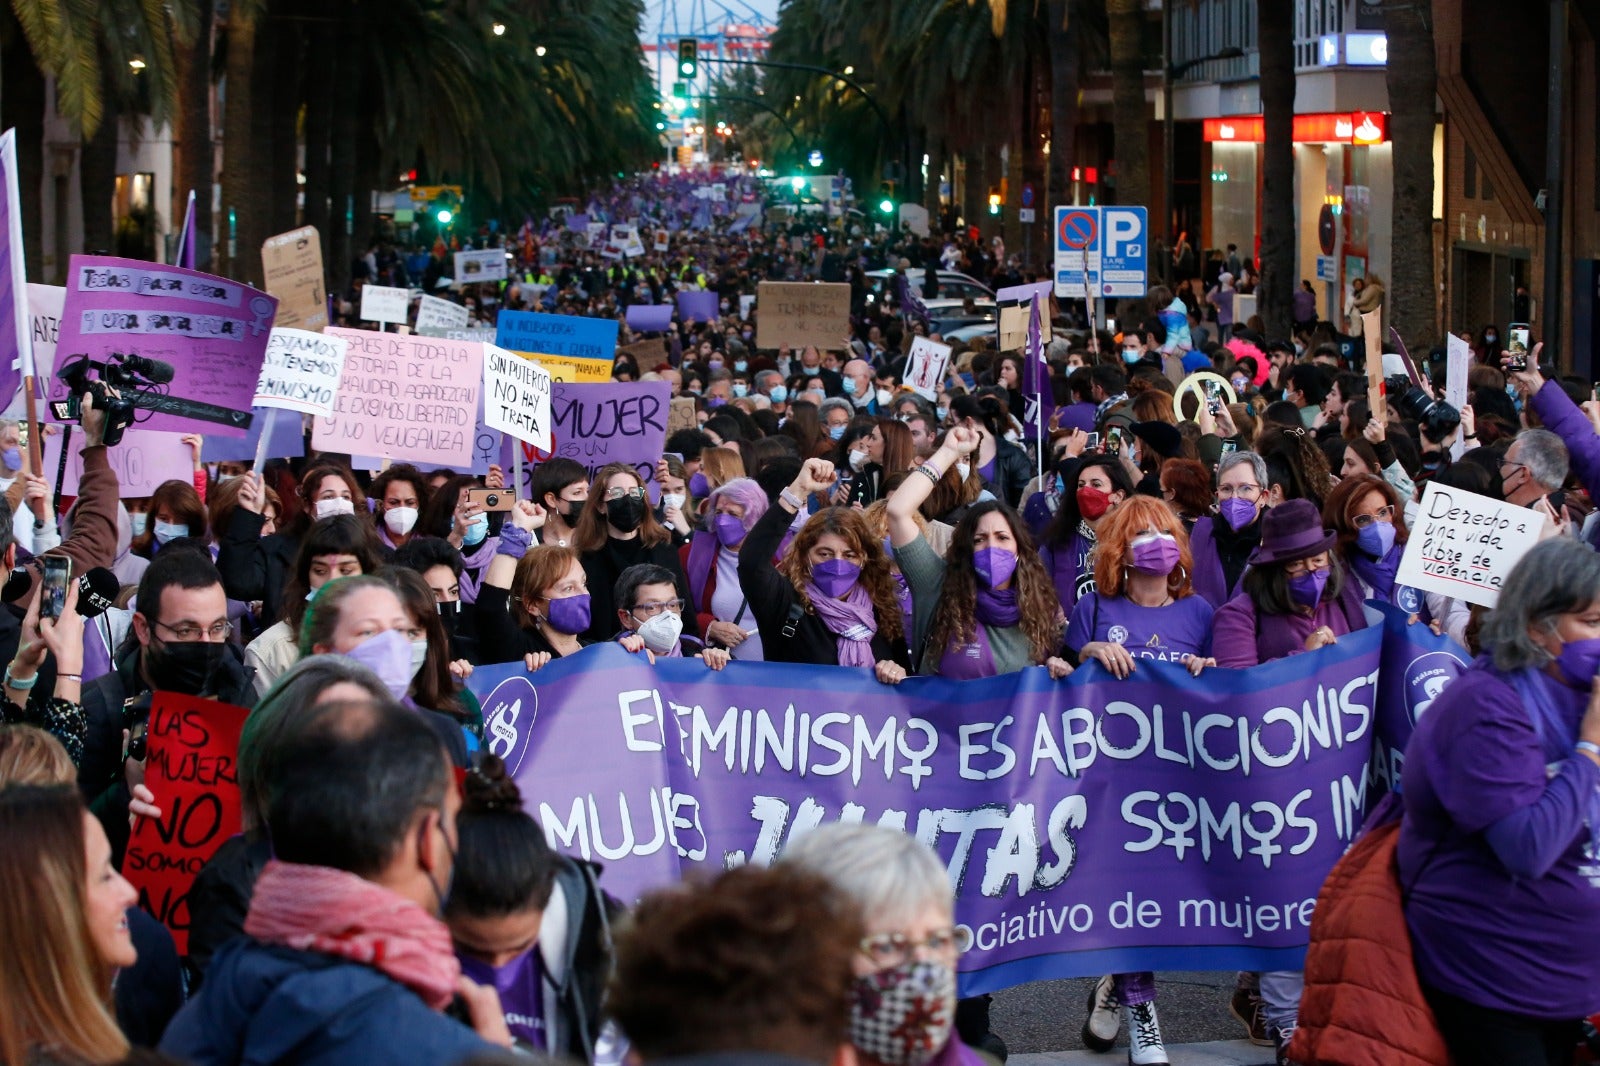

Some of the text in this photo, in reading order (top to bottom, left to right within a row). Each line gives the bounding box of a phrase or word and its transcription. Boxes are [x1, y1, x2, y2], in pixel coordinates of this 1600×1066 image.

[1106, 211, 1141, 257] P
[407, 362, 425, 378] DE
[431, 364, 452, 380] LA
[450, 348, 468, 362] LA
[489, 354, 506, 375] SIN
[508, 360, 549, 395] PUTEROS
[406, 403, 469, 426] LIBERTAD
[494, 378, 517, 403] NO
[521, 390, 540, 414] HAY
[501, 405, 541, 438] TRATA
[551, 394, 665, 439] MUJER
[343, 421, 364, 440] NO
[374, 423, 464, 452] VENGANZA
[1427, 491, 1510, 529] Derecho
[1421, 537, 1491, 569] libre de
[1424, 522, 1504, 551] una vida
[1423, 562, 1504, 589] violencia
[1411, 667, 1446, 687] Málaga
[152, 707, 210, 749] LAS
[146, 744, 239, 786] MUJER
[958, 715, 1017, 781] ES
[136, 792, 223, 849] NO
[1120, 788, 1319, 869] SOMOS
[1108, 891, 1163, 929] de
